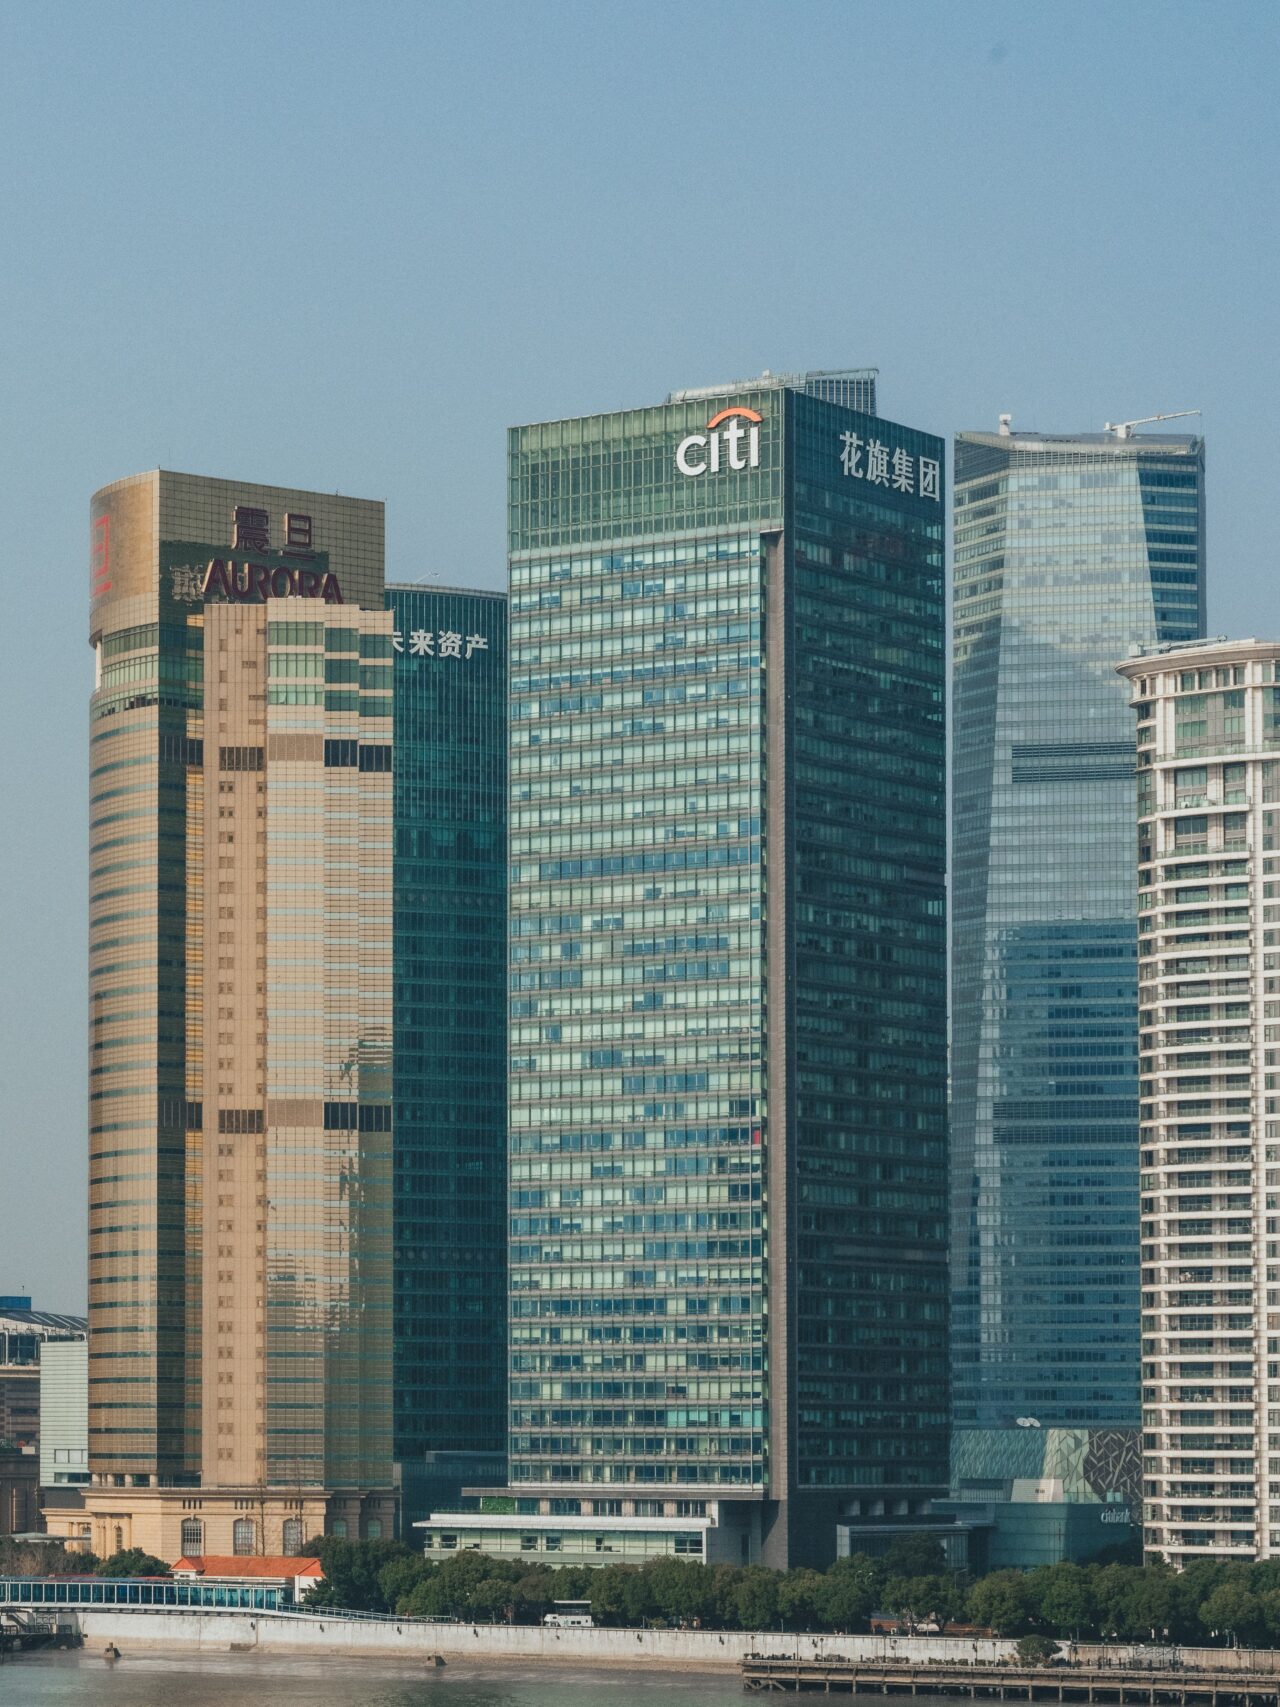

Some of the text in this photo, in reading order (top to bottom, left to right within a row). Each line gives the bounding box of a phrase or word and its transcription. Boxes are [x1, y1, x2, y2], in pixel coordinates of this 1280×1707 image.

[676, 411, 761, 476] citi
[839, 430, 939, 502] 花旗集团
[230, 504, 317, 560] 震旦
[201, 557, 344, 605] AURORA
